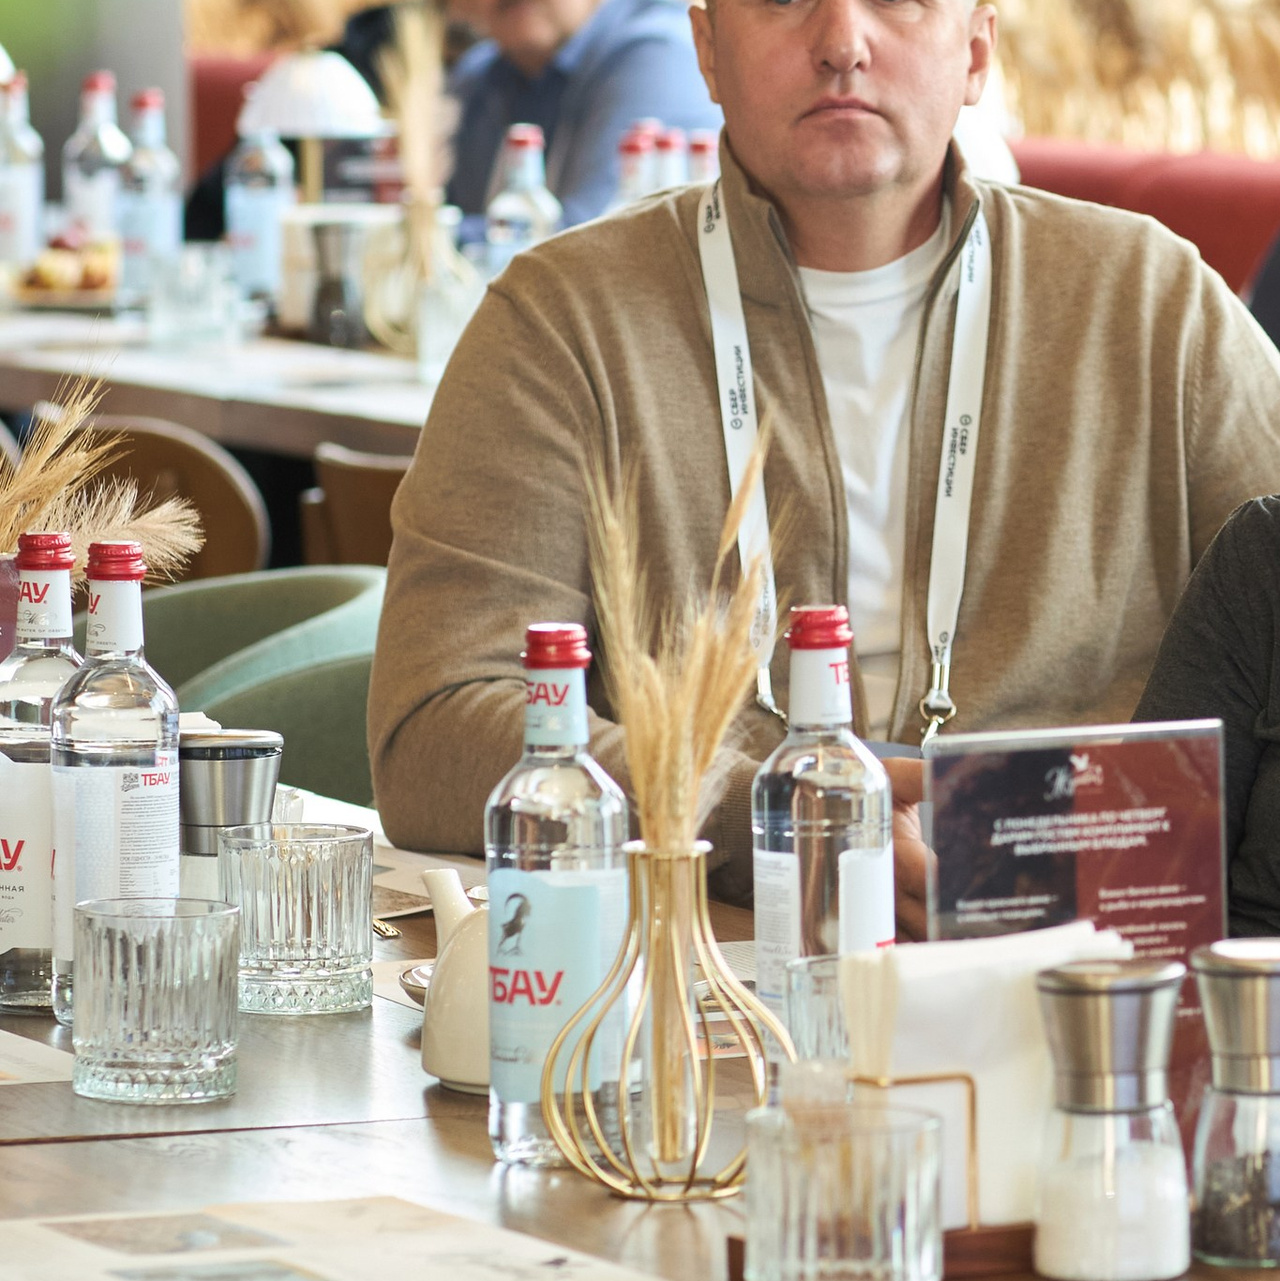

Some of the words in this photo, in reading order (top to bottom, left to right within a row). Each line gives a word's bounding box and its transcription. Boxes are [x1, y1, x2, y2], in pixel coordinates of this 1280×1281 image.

[734, 345, 748, 414] ИНВЕСТИЦИИ
[729, 388, 739, 416] СБЕР
[959, 428, 968, 455] СБЕР
[945, 427, 957, 497] ИНВЕСТИЦИИ
[18, 581, 50, 604] АУ
[141, 772, 170, 787] ТБАУ
